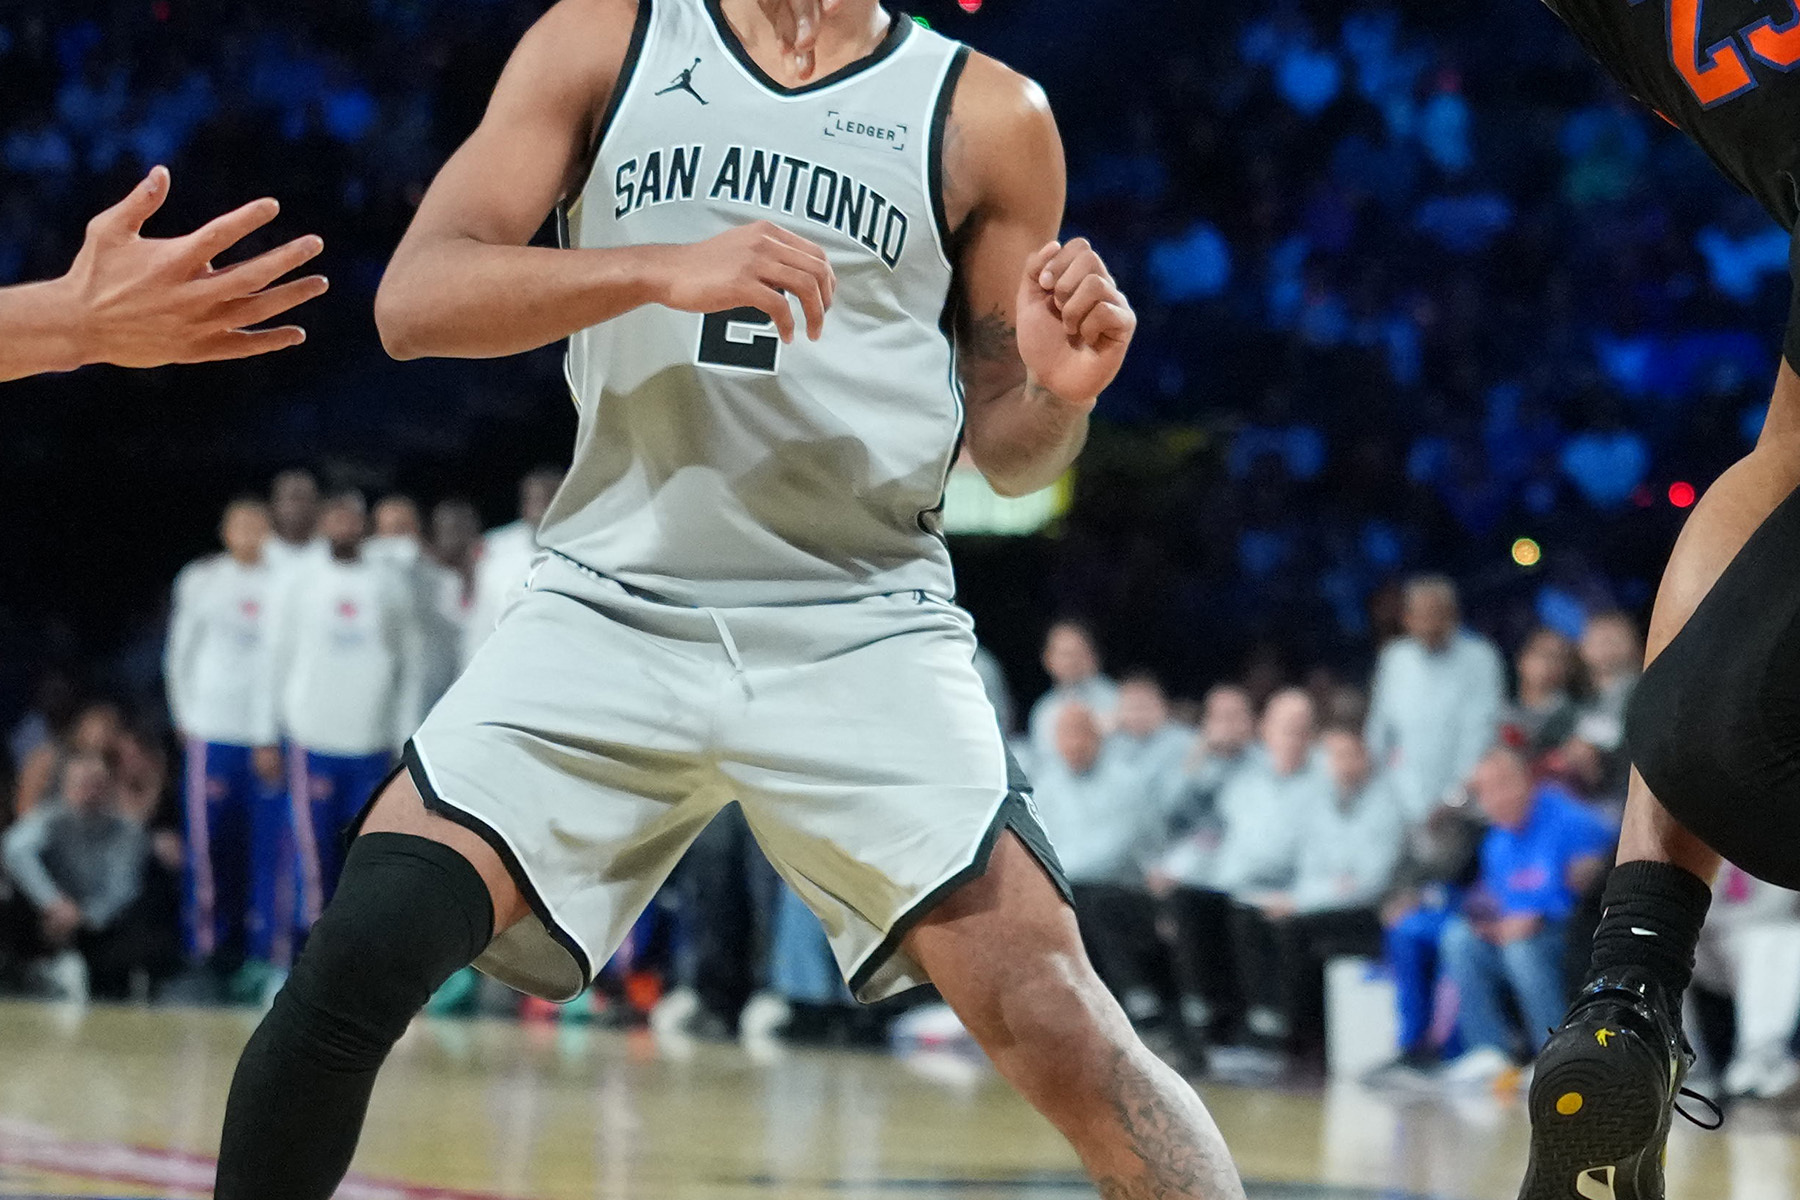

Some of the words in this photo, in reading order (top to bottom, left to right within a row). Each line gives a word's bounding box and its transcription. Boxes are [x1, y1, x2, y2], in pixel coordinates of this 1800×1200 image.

[835, 119, 896, 142] LEDGER
[613, 144, 704, 222] SAN
[706, 144, 910, 274] ANTONIO
